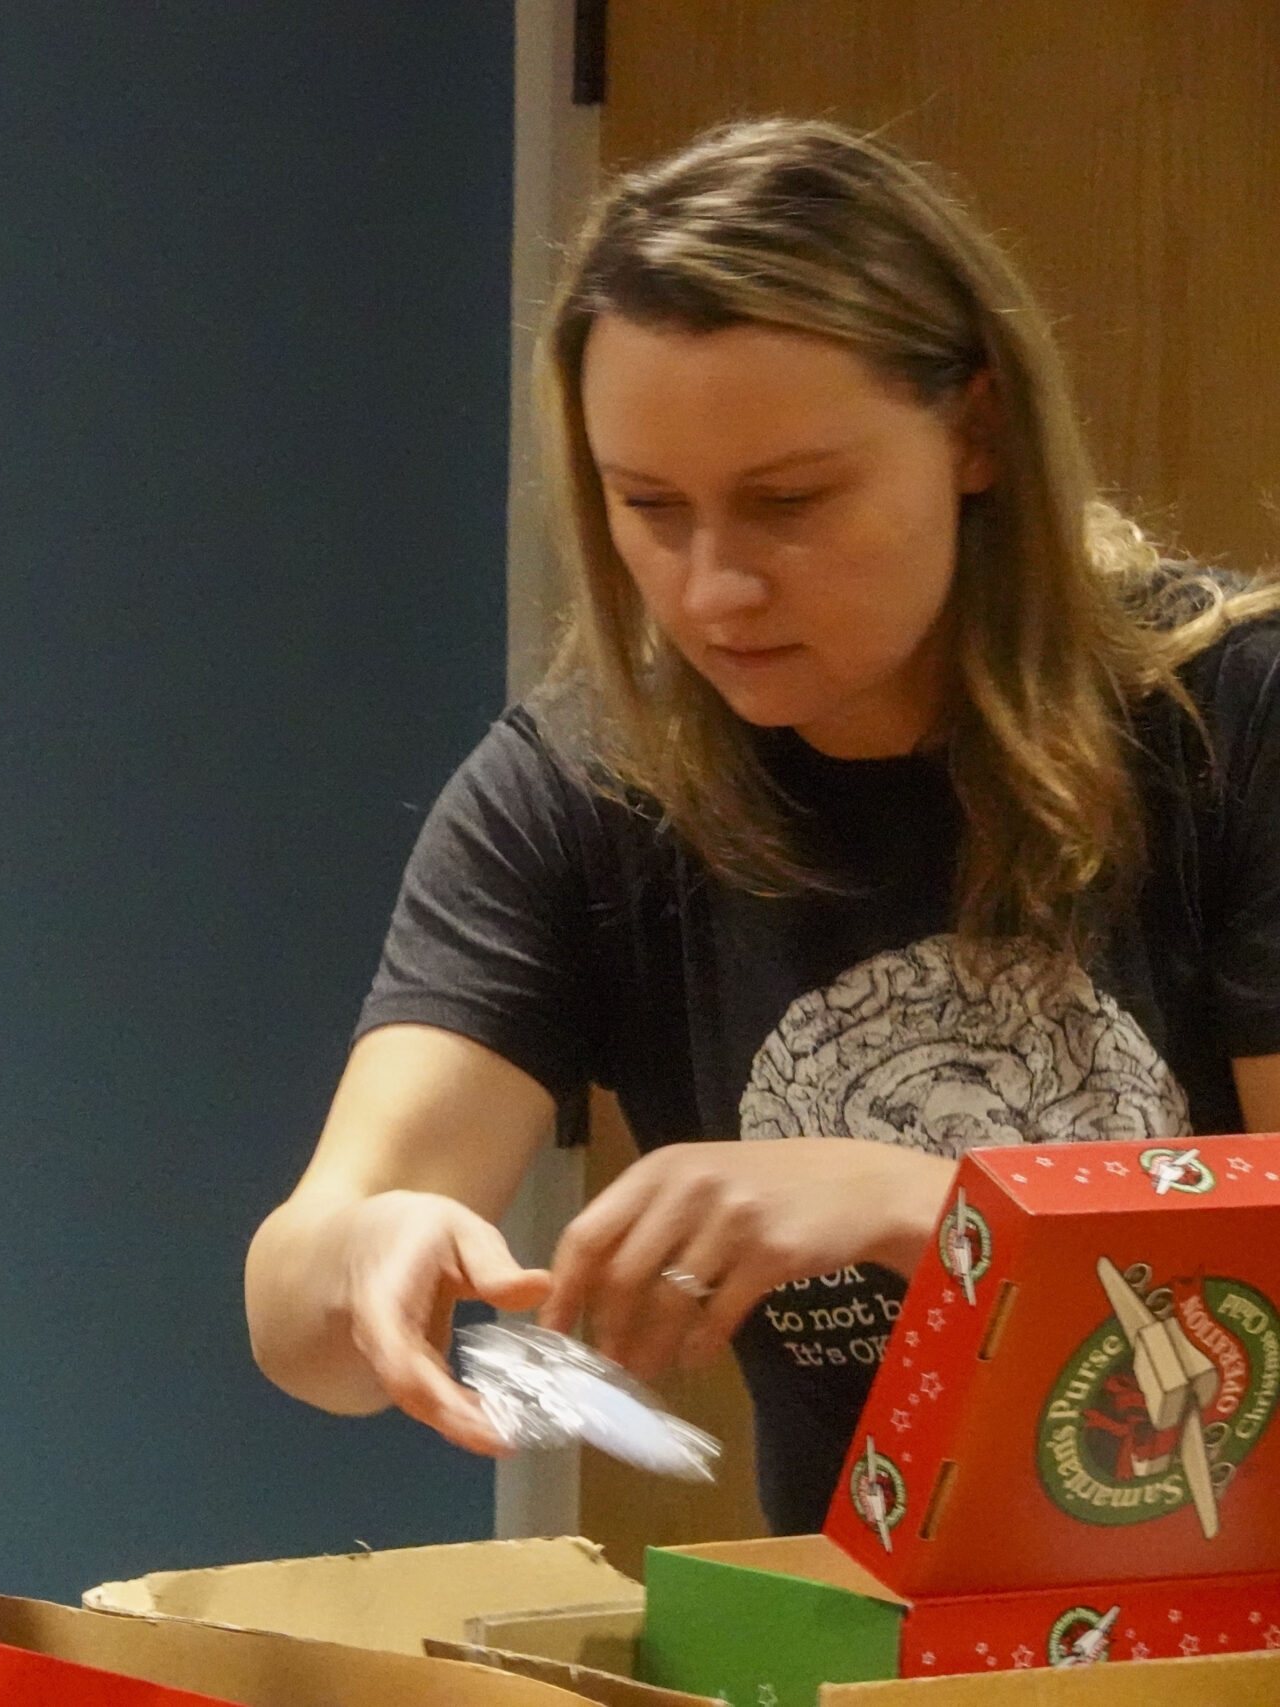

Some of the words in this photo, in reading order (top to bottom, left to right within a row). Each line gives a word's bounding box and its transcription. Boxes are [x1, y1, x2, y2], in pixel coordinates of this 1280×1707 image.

[766, 1303, 804, 1333] to
[809, 1297, 875, 1332] not
[874, 1294, 904, 1322] b
[784, 1340, 847, 1367] It's
[1048, 1334, 1122, 1420] Purse
[1046, 1425, 1184, 1508] Samaritan's
